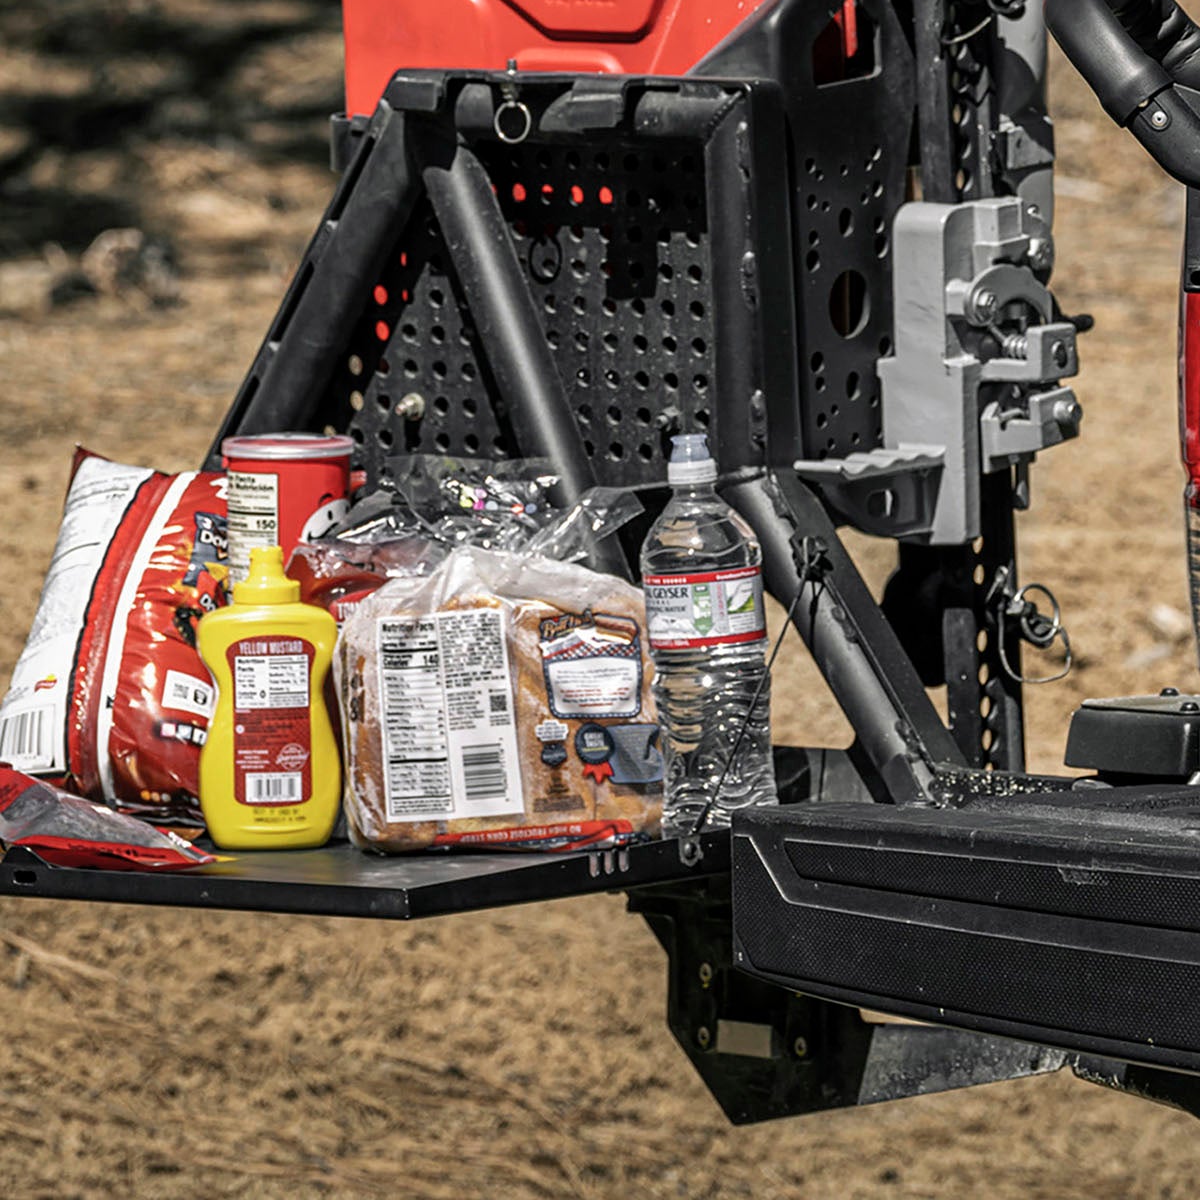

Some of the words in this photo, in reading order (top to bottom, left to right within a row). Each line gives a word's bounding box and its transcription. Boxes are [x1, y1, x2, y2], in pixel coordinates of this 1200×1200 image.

[256, 519, 277, 531] 150
[653, 587, 688, 599] GEYSER
[239, 642, 267, 654] YELLOW
[270, 641, 303, 653] MUSTARD
